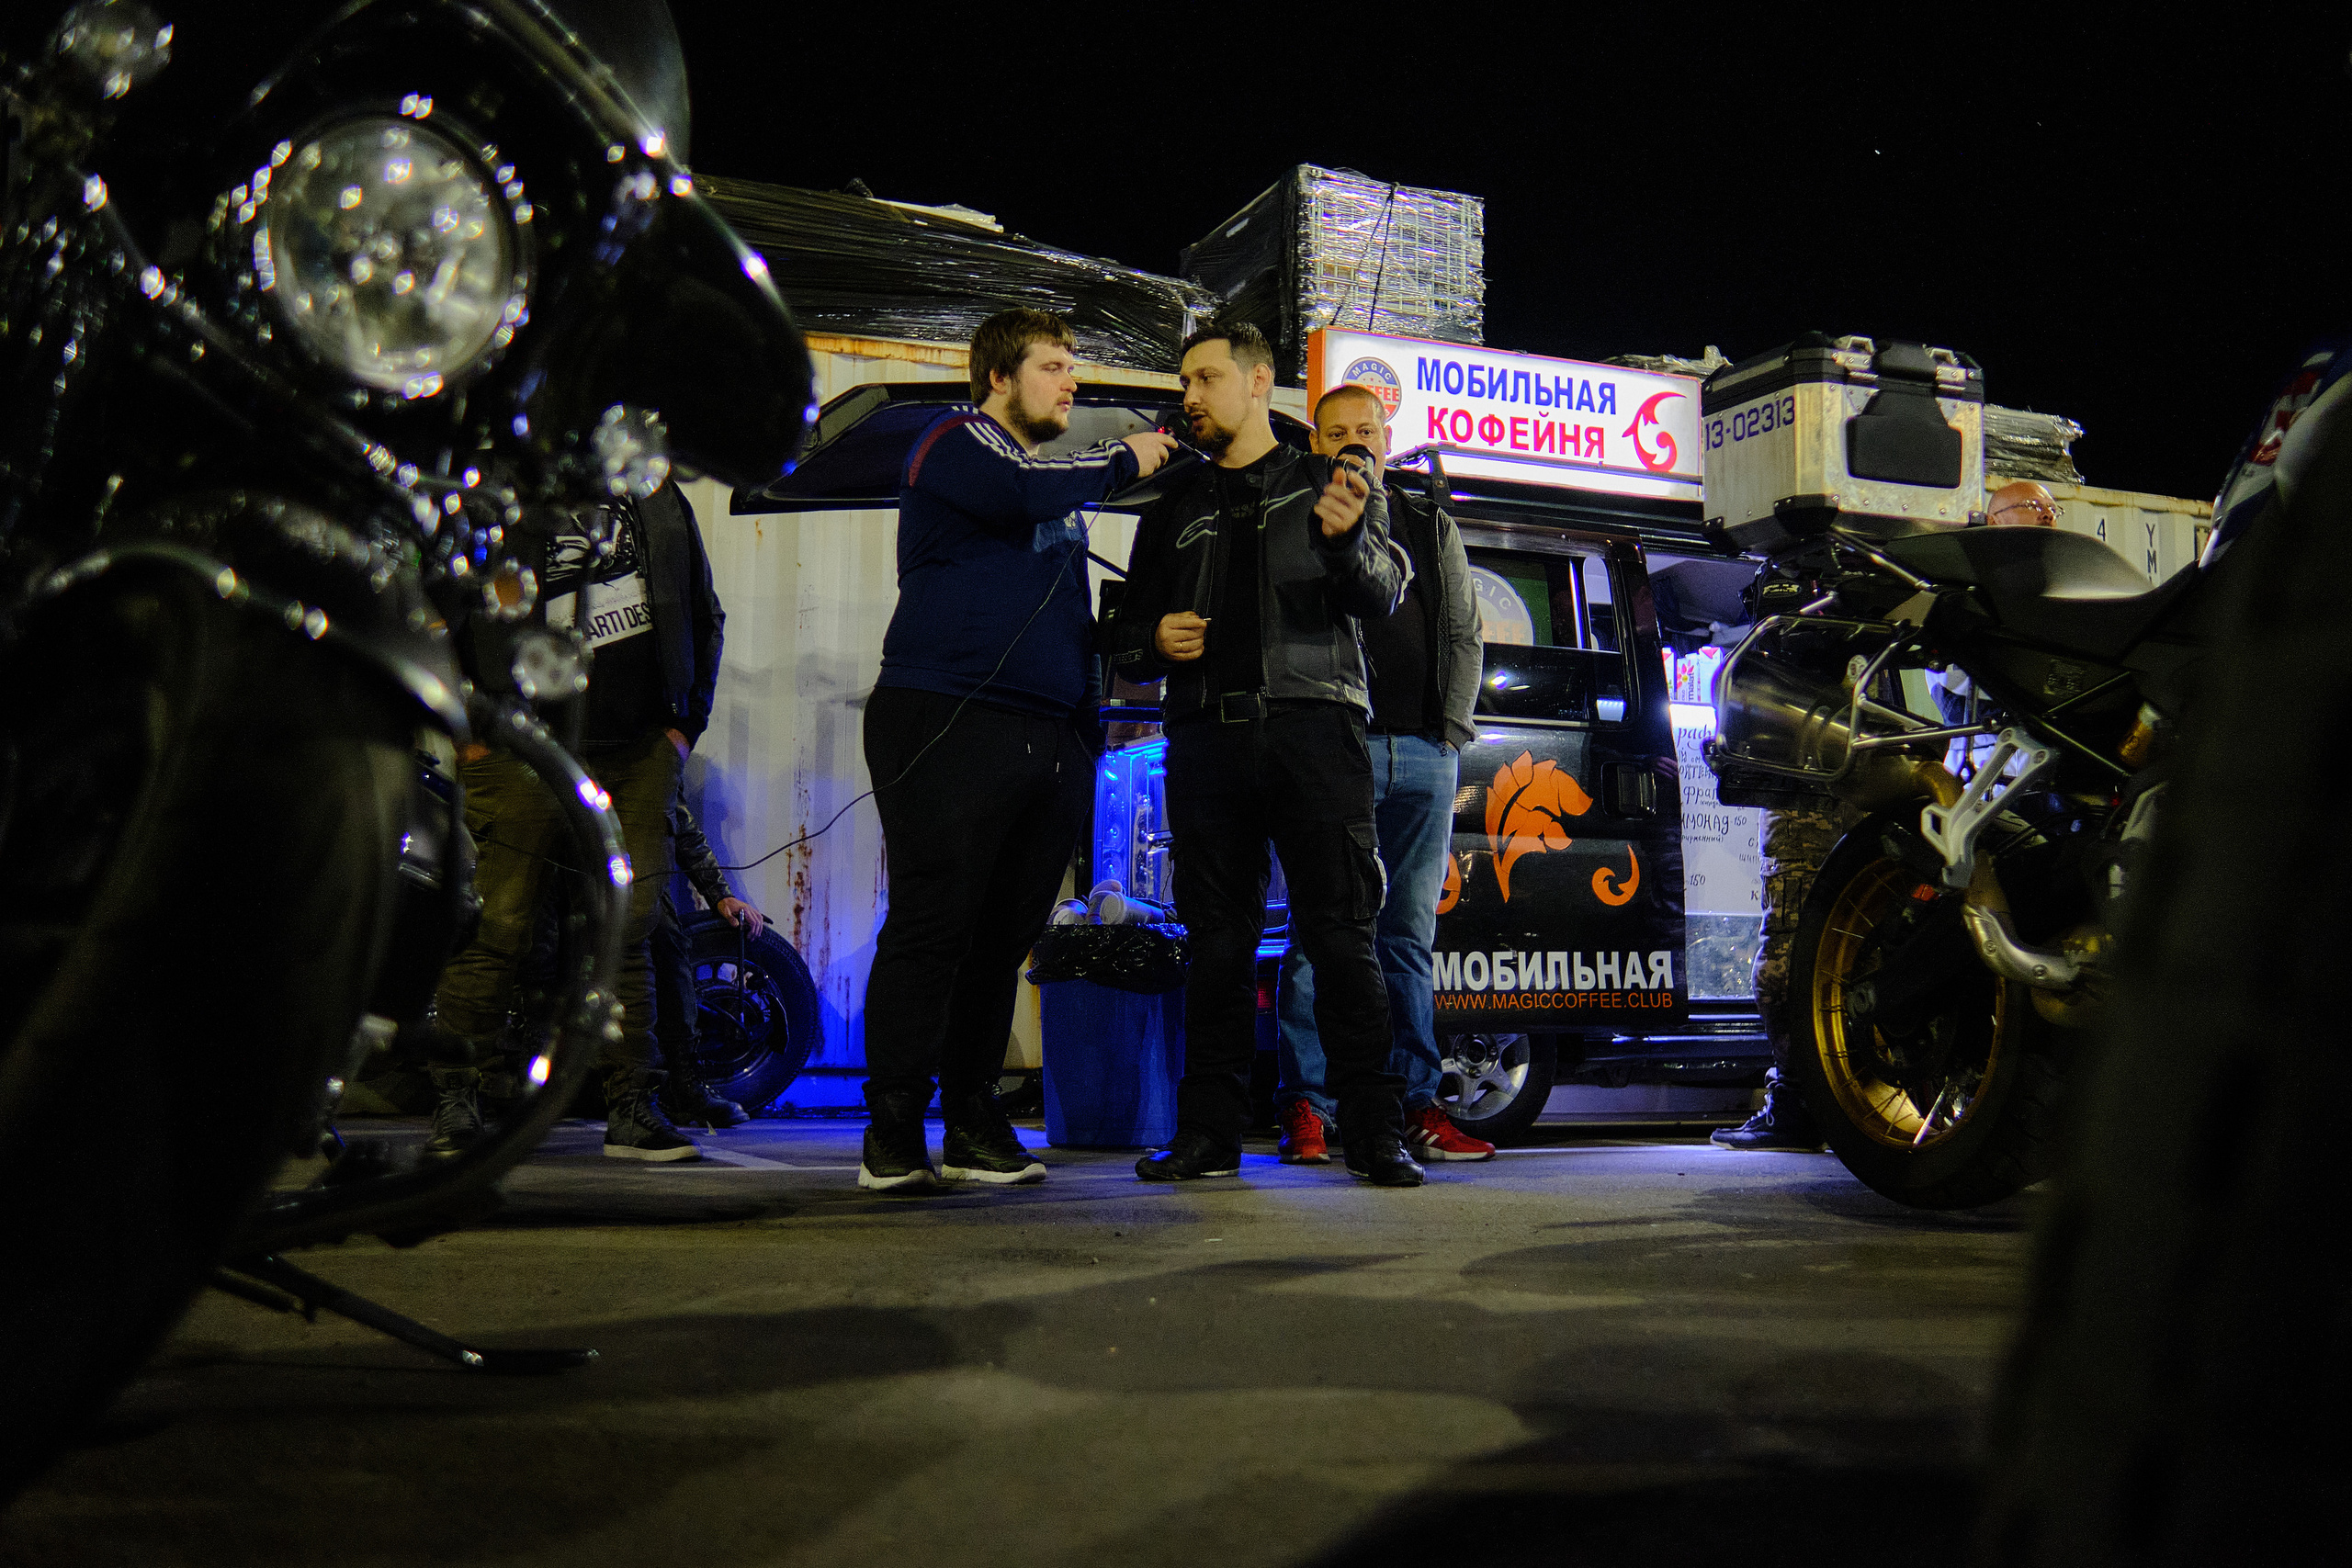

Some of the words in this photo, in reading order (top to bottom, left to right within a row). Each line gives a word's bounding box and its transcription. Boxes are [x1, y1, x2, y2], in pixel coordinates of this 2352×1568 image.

[1351, 362, 1392, 380] MAGIC
[1417, 356, 1617, 415] МОБИЛЬНАЯ
[1427, 405, 1605, 459] КОФЕЙНЯ
[1705, 395, 1795, 452] 13-02313
[2097, 518, 2106, 542] 4
[1472, 577, 1511, 610] GIC
[1431, 951, 1674, 991] МОБИЛЬНАЯ
[1434, 993, 1673, 1010] WWW.MAGICCOFFEE.CLUB
